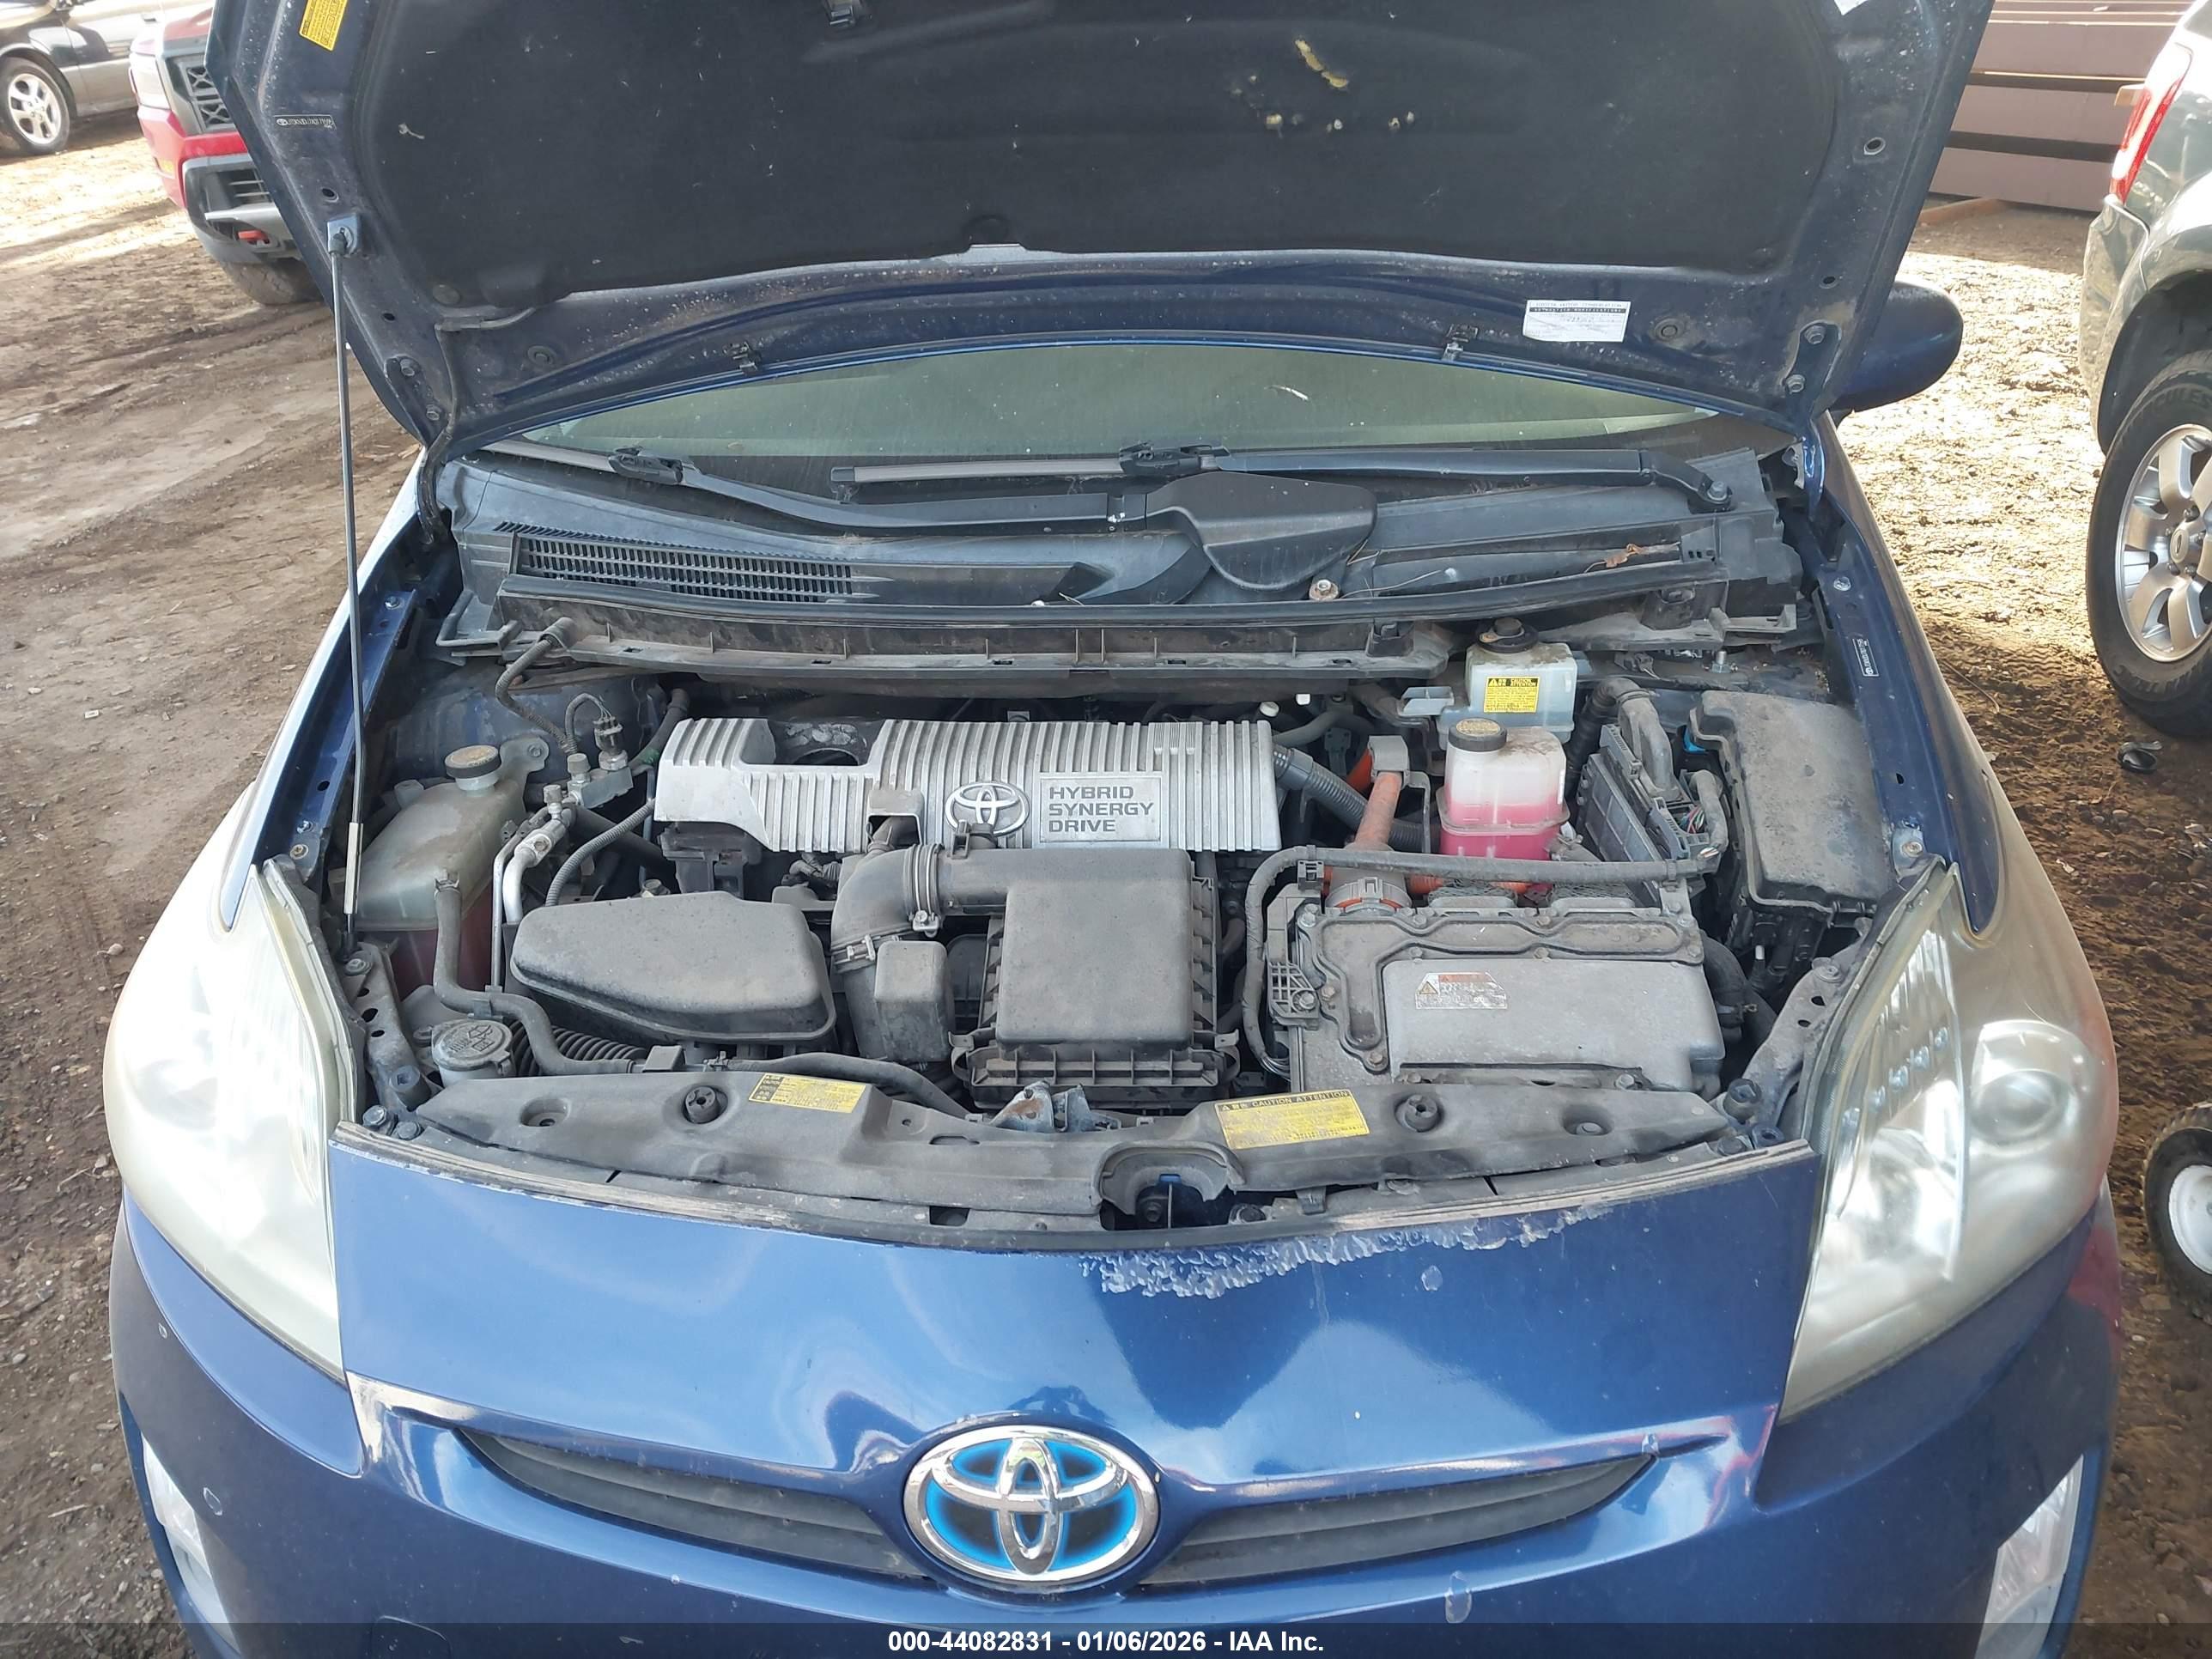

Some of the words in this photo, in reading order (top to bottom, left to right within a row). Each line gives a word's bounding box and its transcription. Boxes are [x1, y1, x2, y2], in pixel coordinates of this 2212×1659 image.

[1048, 786, 1134, 799] HYBRID
[1048, 802, 1154, 817] SYNERGY
[1048, 819, 1116, 833] DRIVE
[1251, 1097, 1292, 1108] CAUTION
[1296, 1091, 1349, 1103] ATTENTION
